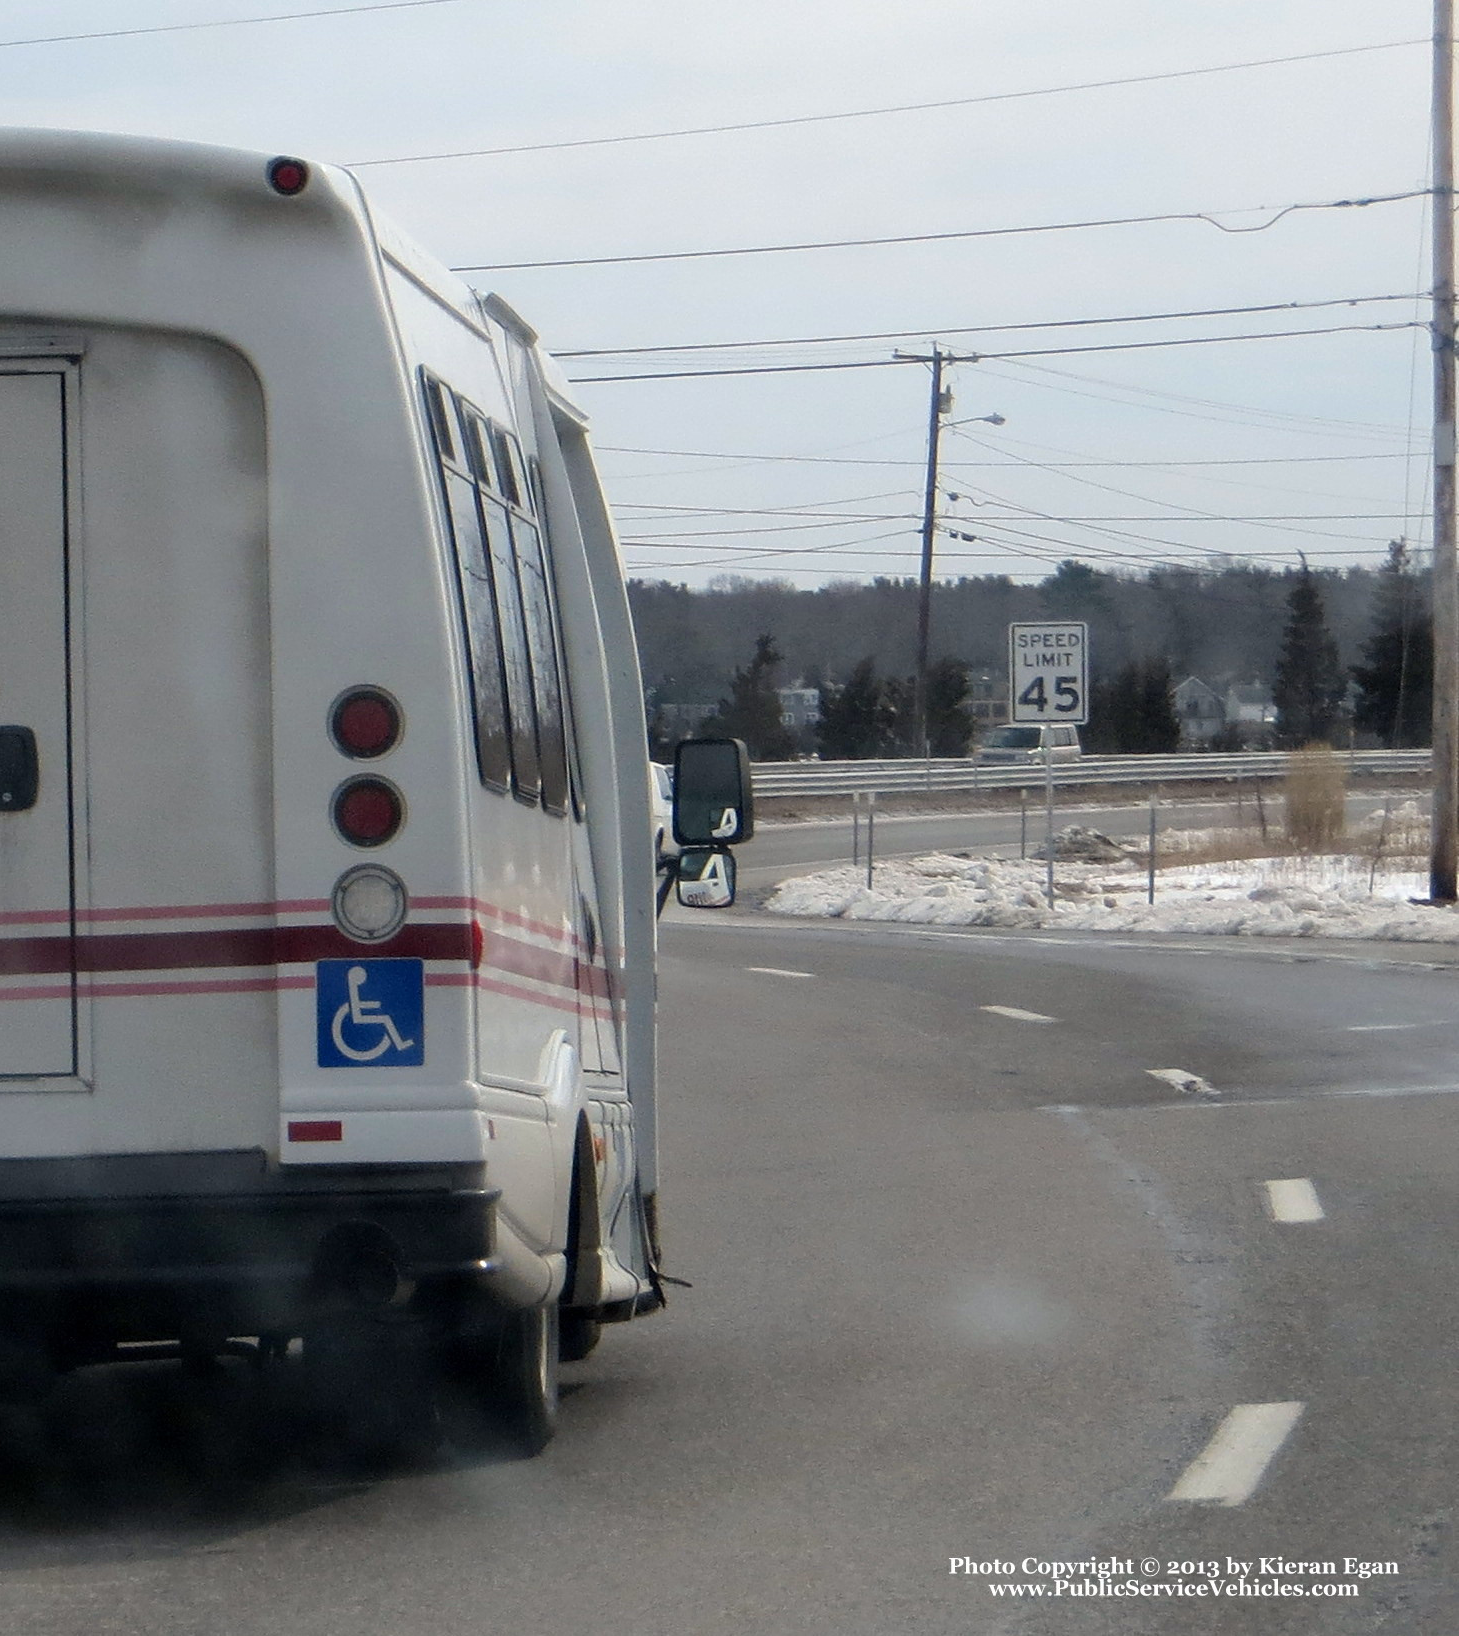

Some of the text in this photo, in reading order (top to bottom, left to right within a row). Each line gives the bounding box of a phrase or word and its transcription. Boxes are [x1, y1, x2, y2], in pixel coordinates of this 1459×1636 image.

[1017, 633, 1080, 648] SPEED
[1023, 653, 1073, 667] LIMIT
[1017, 676, 1080, 713] 45
